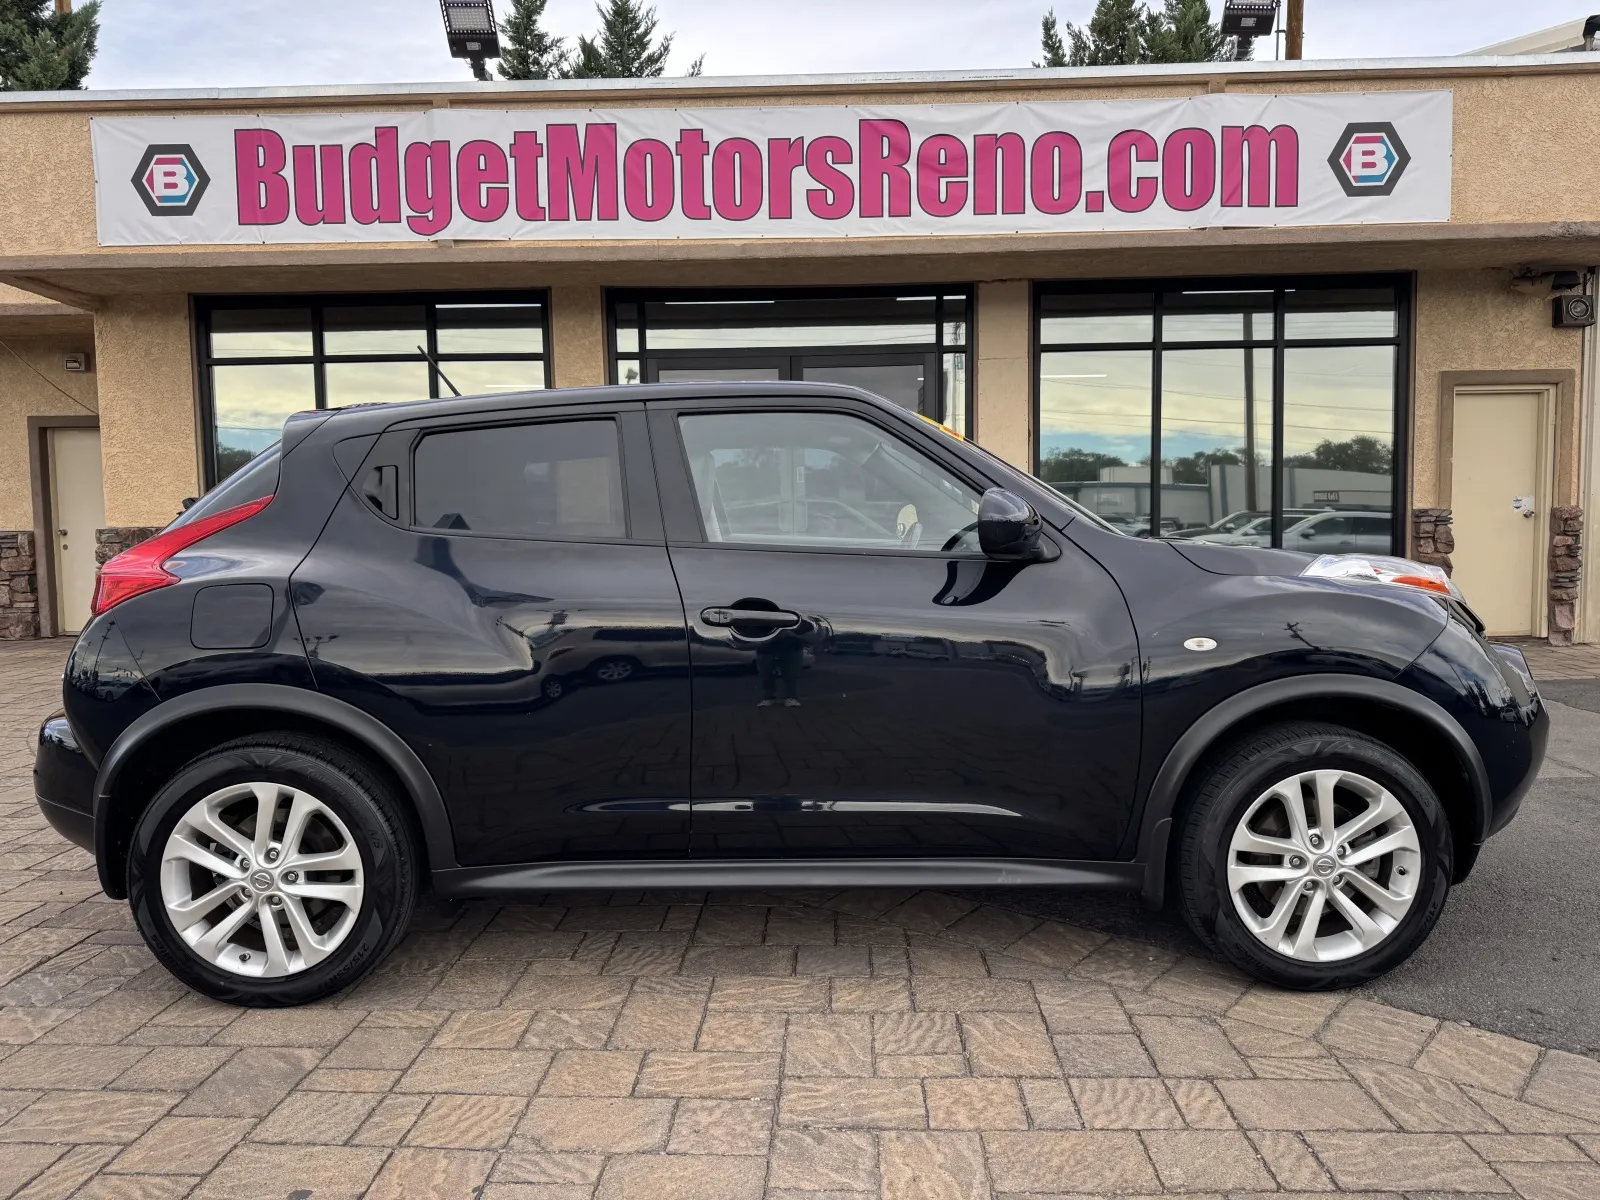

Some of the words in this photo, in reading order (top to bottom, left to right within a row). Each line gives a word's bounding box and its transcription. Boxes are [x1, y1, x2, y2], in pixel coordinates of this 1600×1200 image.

[1351, 142, 1389, 176] B
[152, 164, 190, 197] B
[234, 120, 1299, 236] BudgetMotorsReno.com
